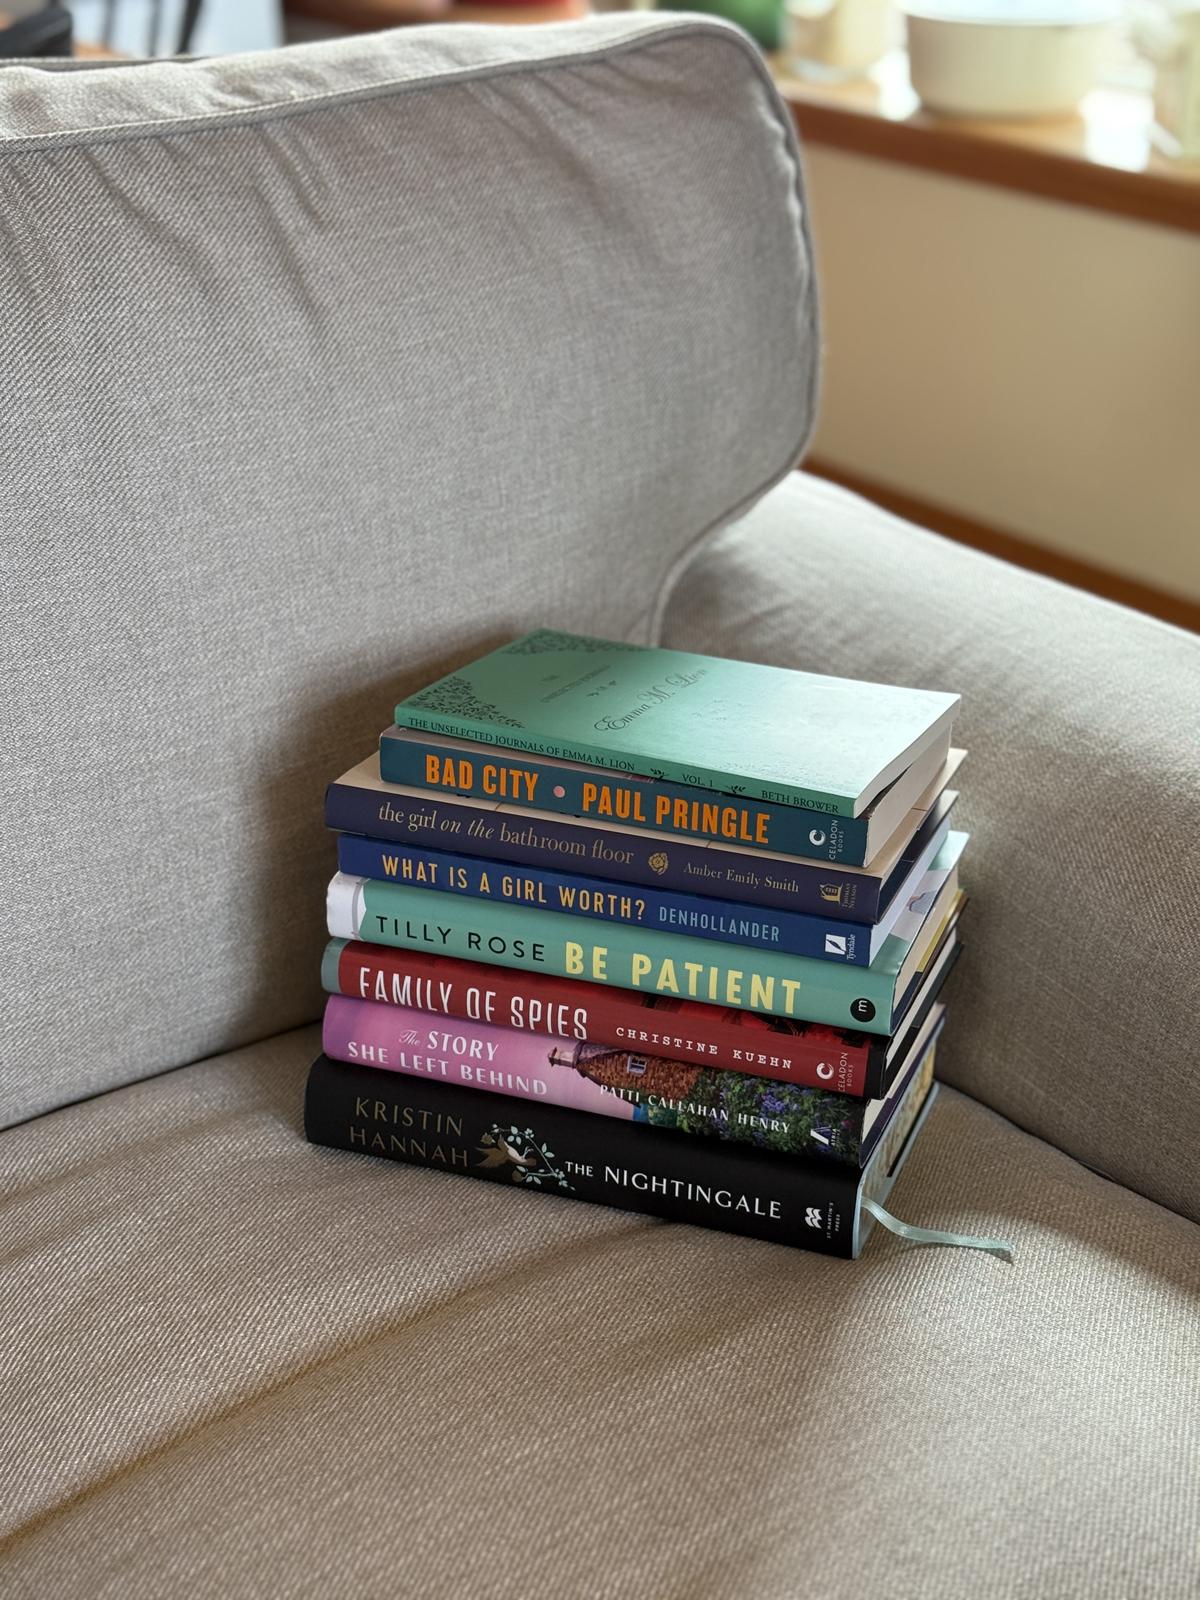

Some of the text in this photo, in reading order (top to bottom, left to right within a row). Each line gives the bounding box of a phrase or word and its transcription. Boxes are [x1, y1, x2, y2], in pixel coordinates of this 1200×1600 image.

[408, 717, 635, 771] THE UNSELECTED JOURNALS OF EMMA M. LION
[426, 754, 539, 801] BAD CITY
[682, 774, 705, 786] VOL.
[582, 782, 770, 843] PAUL PRINGLE
[762, 790, 839, 813] BETH BROWER
[378, 802, 634, 865] the girl on the bathroom floor
[829, 819, 839, 860] CELADON
[382, 854, 645, 920] WHAT IS A GIRL WORTH?
[683, 862, 800, 893] Amber Emily Smith
[375, 915, 545, 962] TILLY ROSE
[659, 906, 780, 942] DENHOLLANDER
[847, 934, 856, 960] Tyndale
[565, 941, 801, 1015] BE PATIENT
[359, 967, 588, 1040] FAMILY OF SPIES
[398, 1029, 500, 1061] The STORY
[616, 1026, 793, 1070] CHRISTINE KUEHN
[347, 1041, 548, 1095] SHE LEFT BEHIND
[838, 1052, 848, 1092] CELADON
[355, 1097, 463, 1137] KRISTIN
[600, 1084, 790, 1134] PATTI CALLAHAN HENRY
[350, 1126, 469, 1167] HANNAH
[564, 1161, 782, 1219] THE NIGHTINGALE
